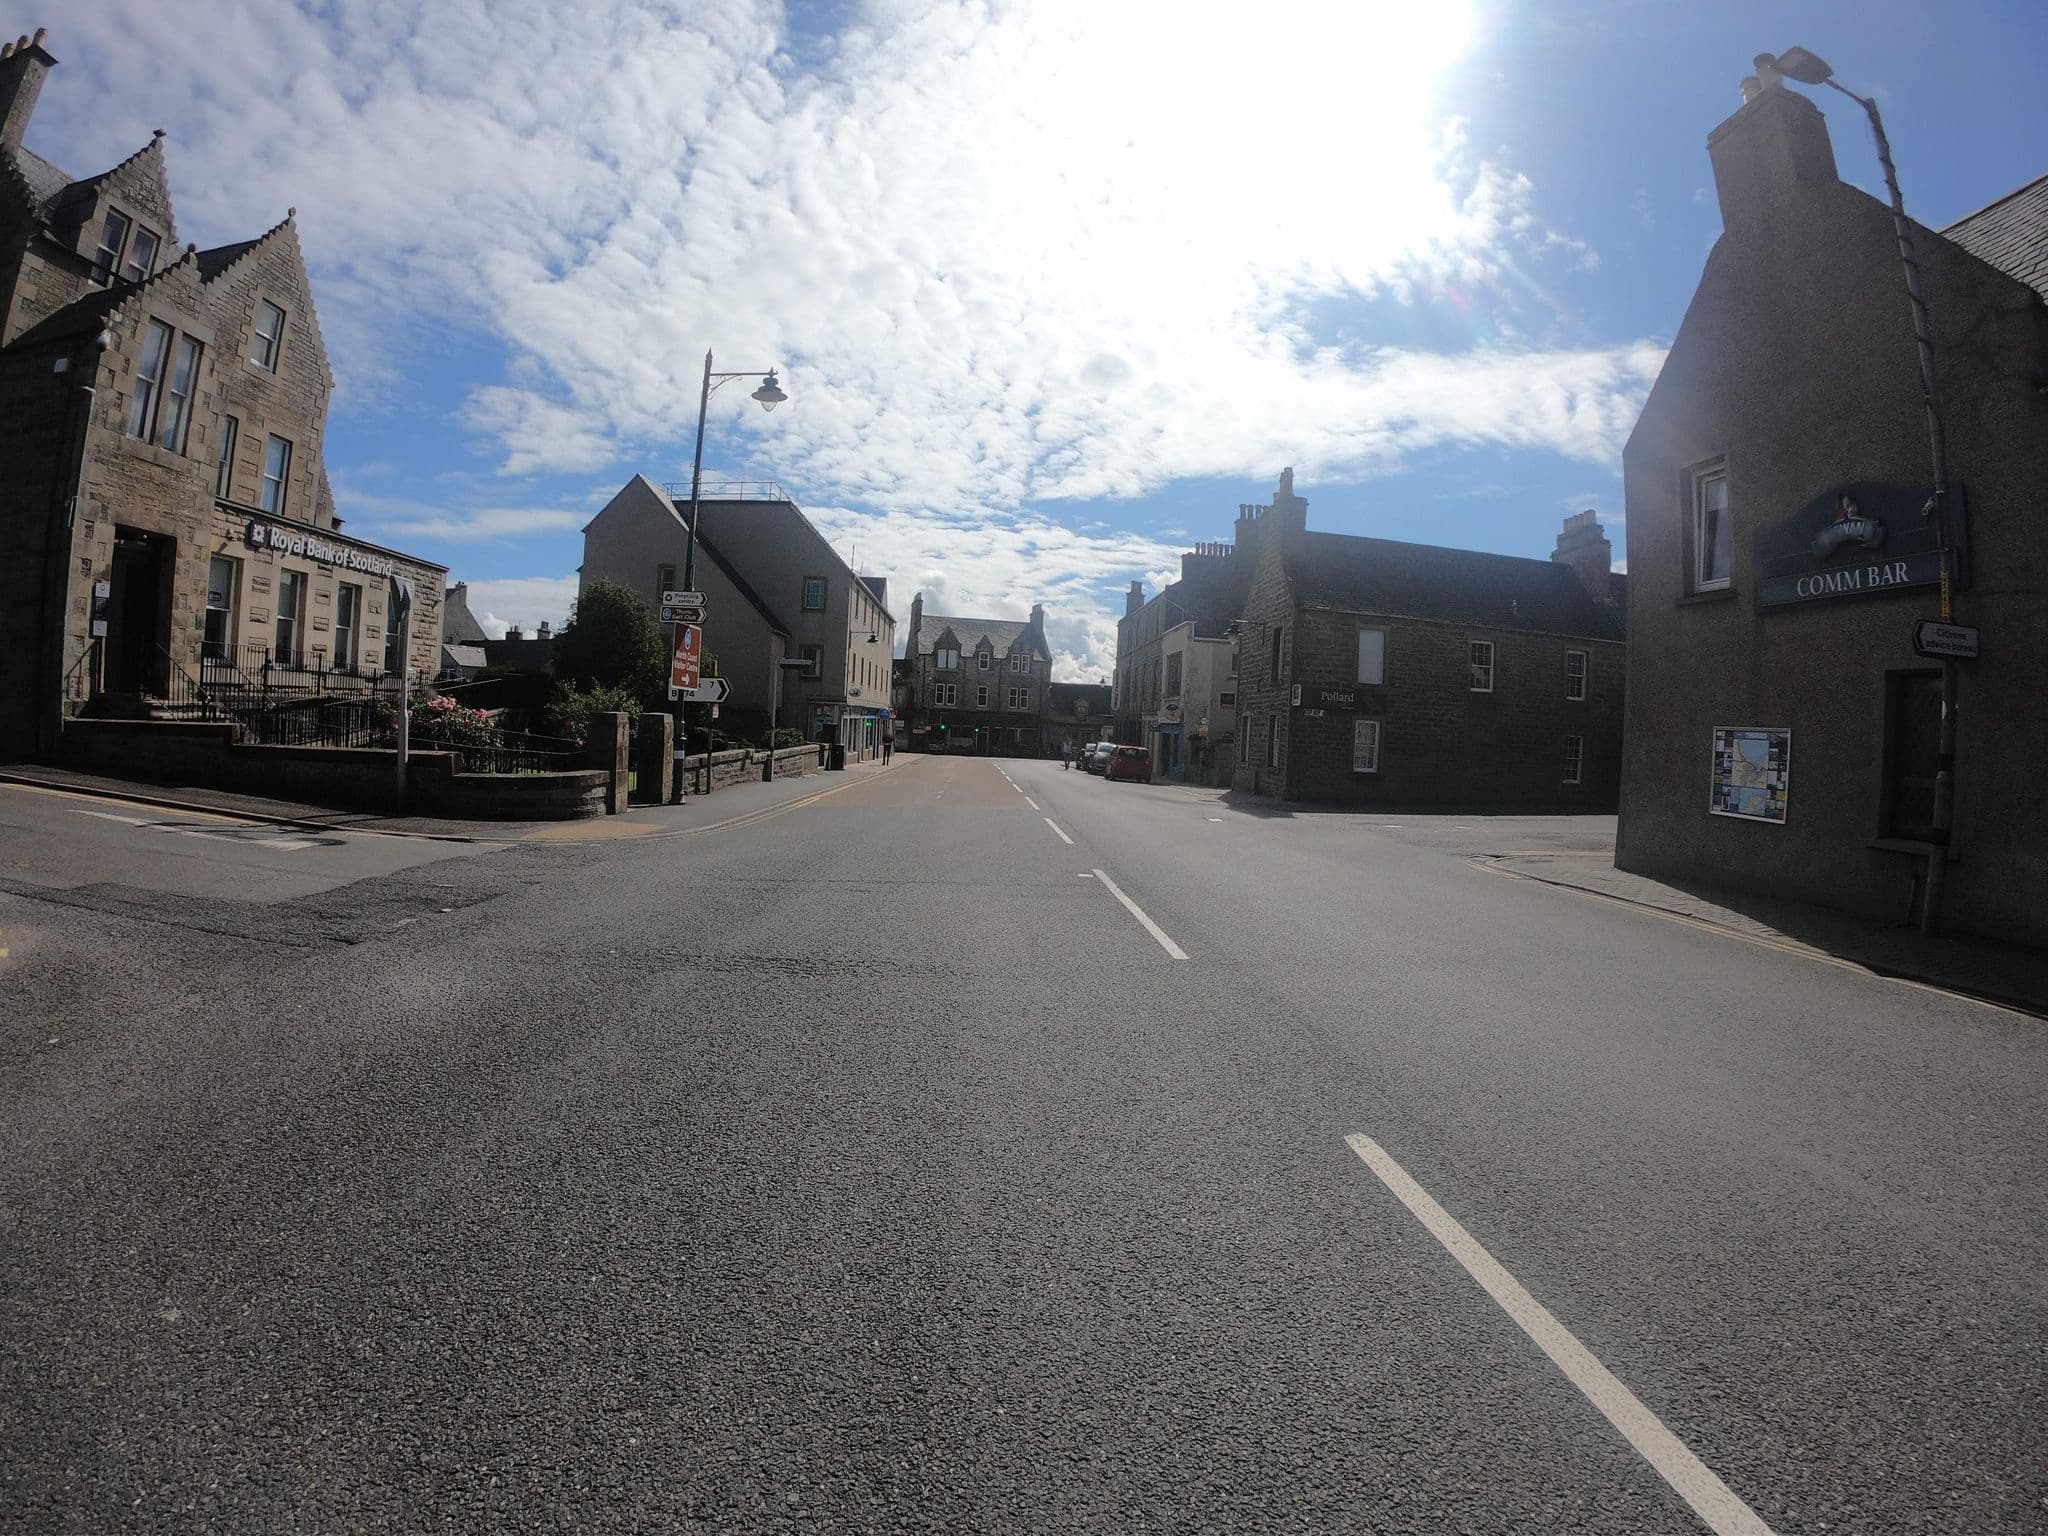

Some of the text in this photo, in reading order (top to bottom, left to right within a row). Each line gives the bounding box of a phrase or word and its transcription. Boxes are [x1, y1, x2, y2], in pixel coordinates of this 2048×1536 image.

[270, 527, 393, 576] Royal Bank of Scotland
[1797, 562, 1910, 597] COMM BAR
[1936, 628, 1968, 640] Citizens
[672, 690, 695, 698] B74
[1321, 690, 1354, 703] Pollard
